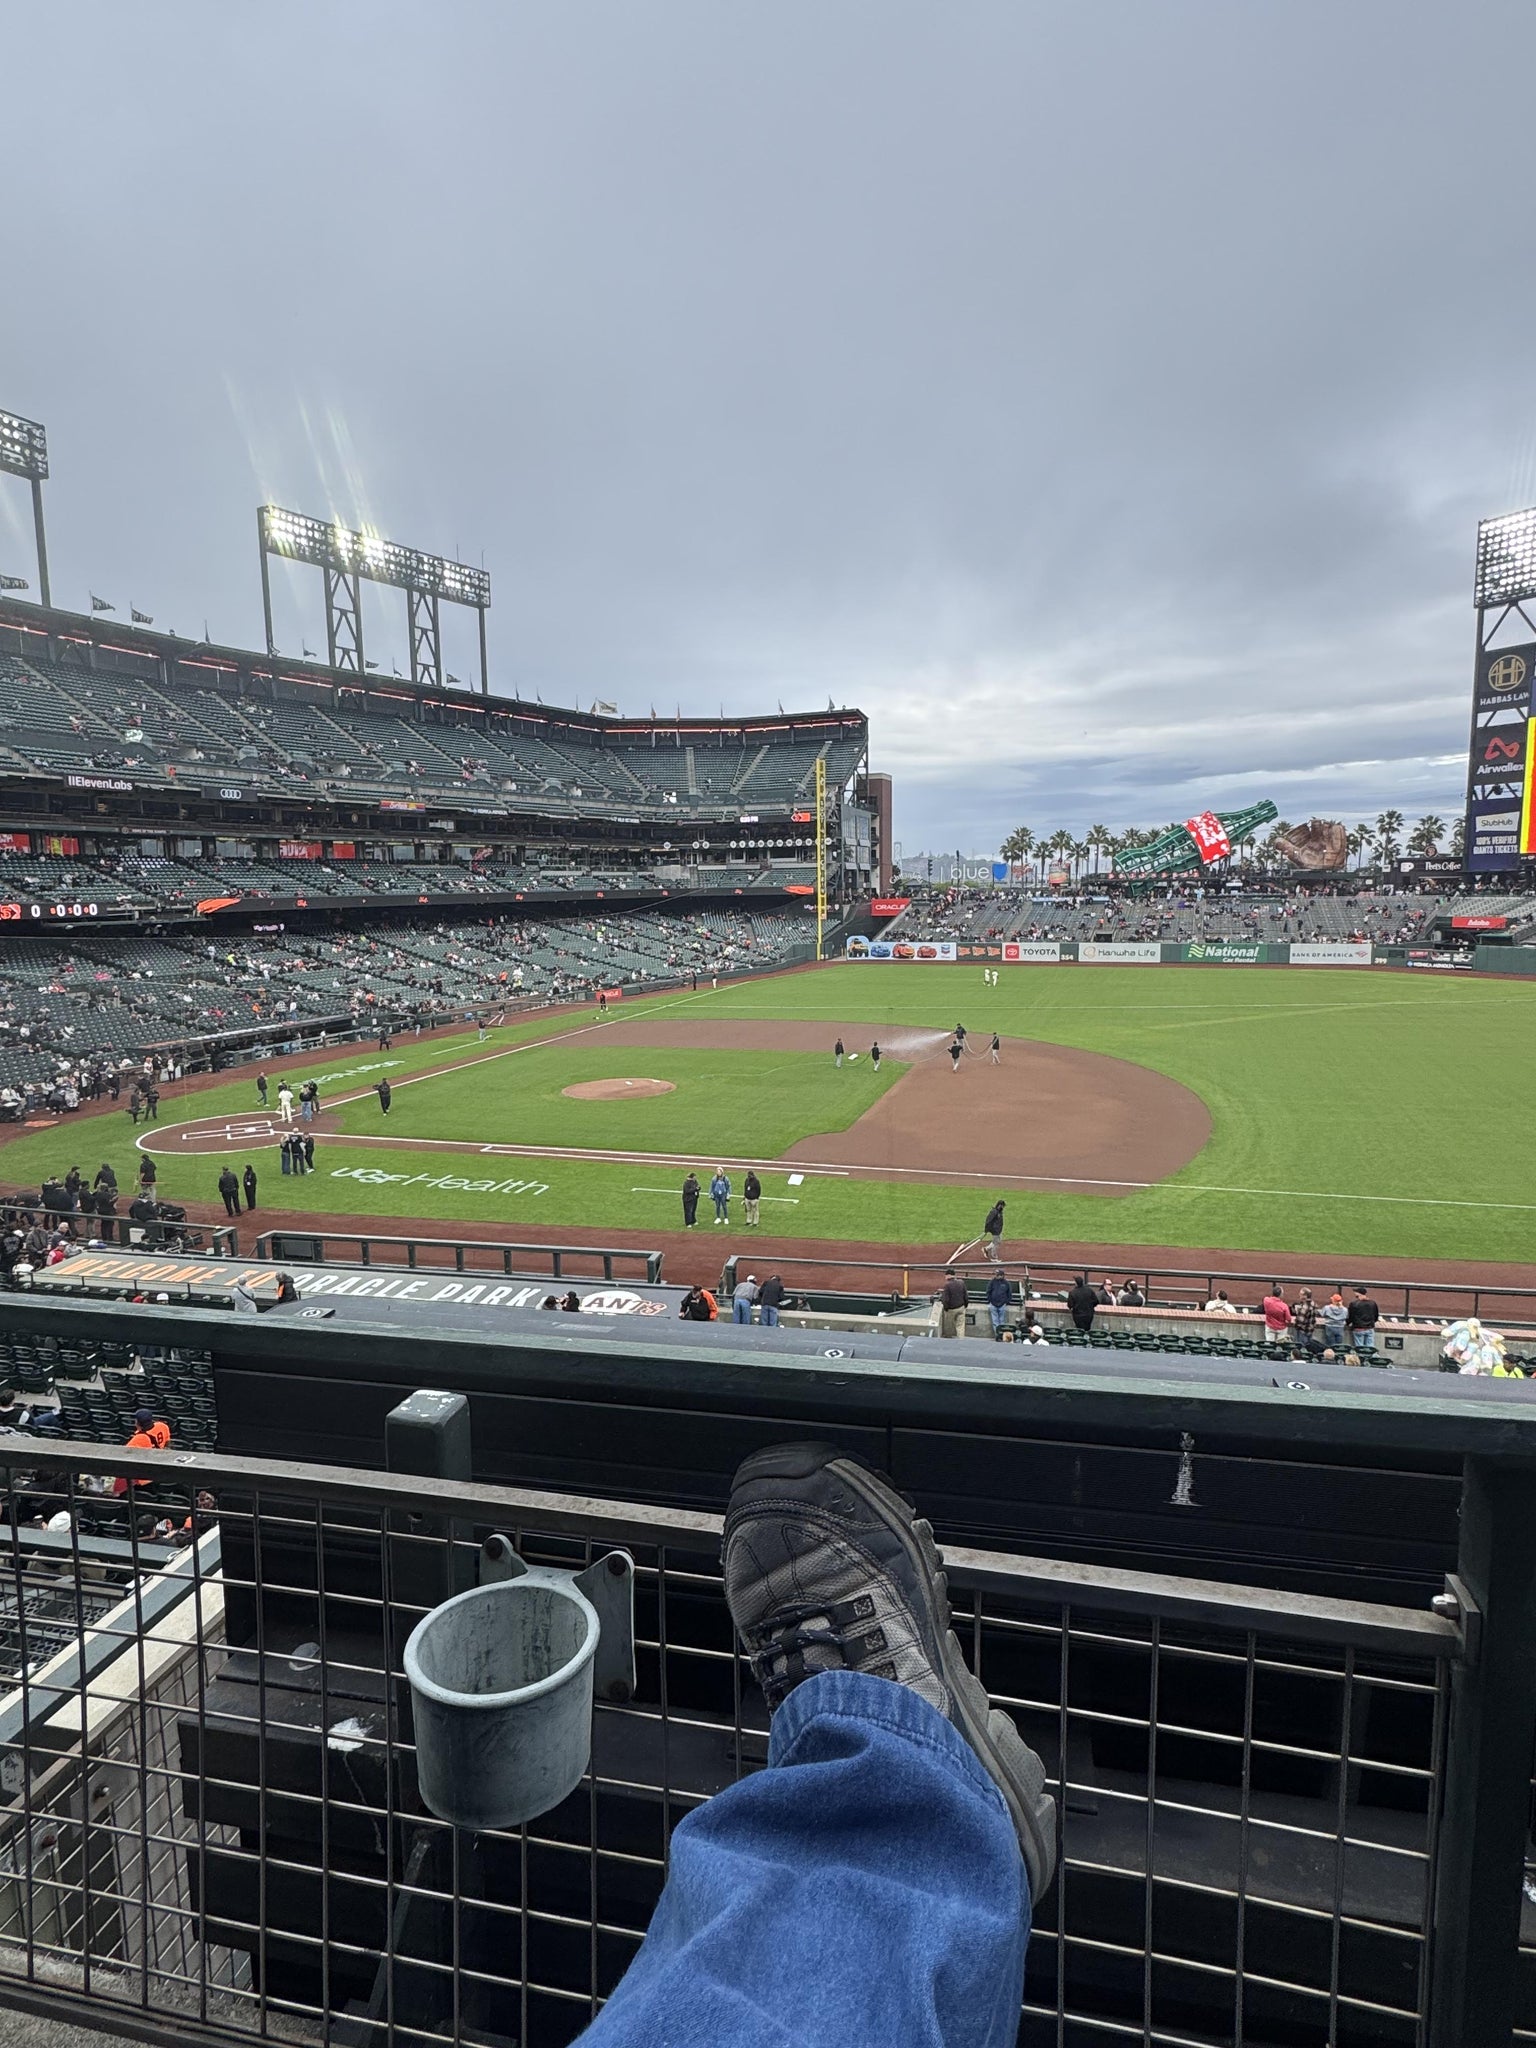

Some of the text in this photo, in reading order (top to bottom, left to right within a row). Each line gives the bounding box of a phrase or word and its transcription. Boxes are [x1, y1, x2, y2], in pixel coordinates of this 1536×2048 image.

[1480, 693, 1512, 706] HABBAS
[1477, 762, 1524, 775] Airwallex
[1481, 818, 1513, 827] StubHub
[1492, 835, 1517, 845] VERIFIED
[1494, 844, 1518, 854] TICKETS
[950, 864, 989, 880] blue
[1441, 861, 1462, 871] Coffee
[31, 904, 41, 918] 0
[56, 904, 66, 917] 0
[73, 903, 82, 916] 0
[89, 903, 98, 916] 0
[1023, 948, 1057, 956] TOYOTA
[1098, 949, 1156, 957] Hanwha Life
[1205, 946, 1259, 957] National
[331, 1167, 549, 1196] UCSF Health
[54, 1258, 543, 1308] WELCOME TO ORACLE PARK
[585, 1296, 668, 1316] ANTS
